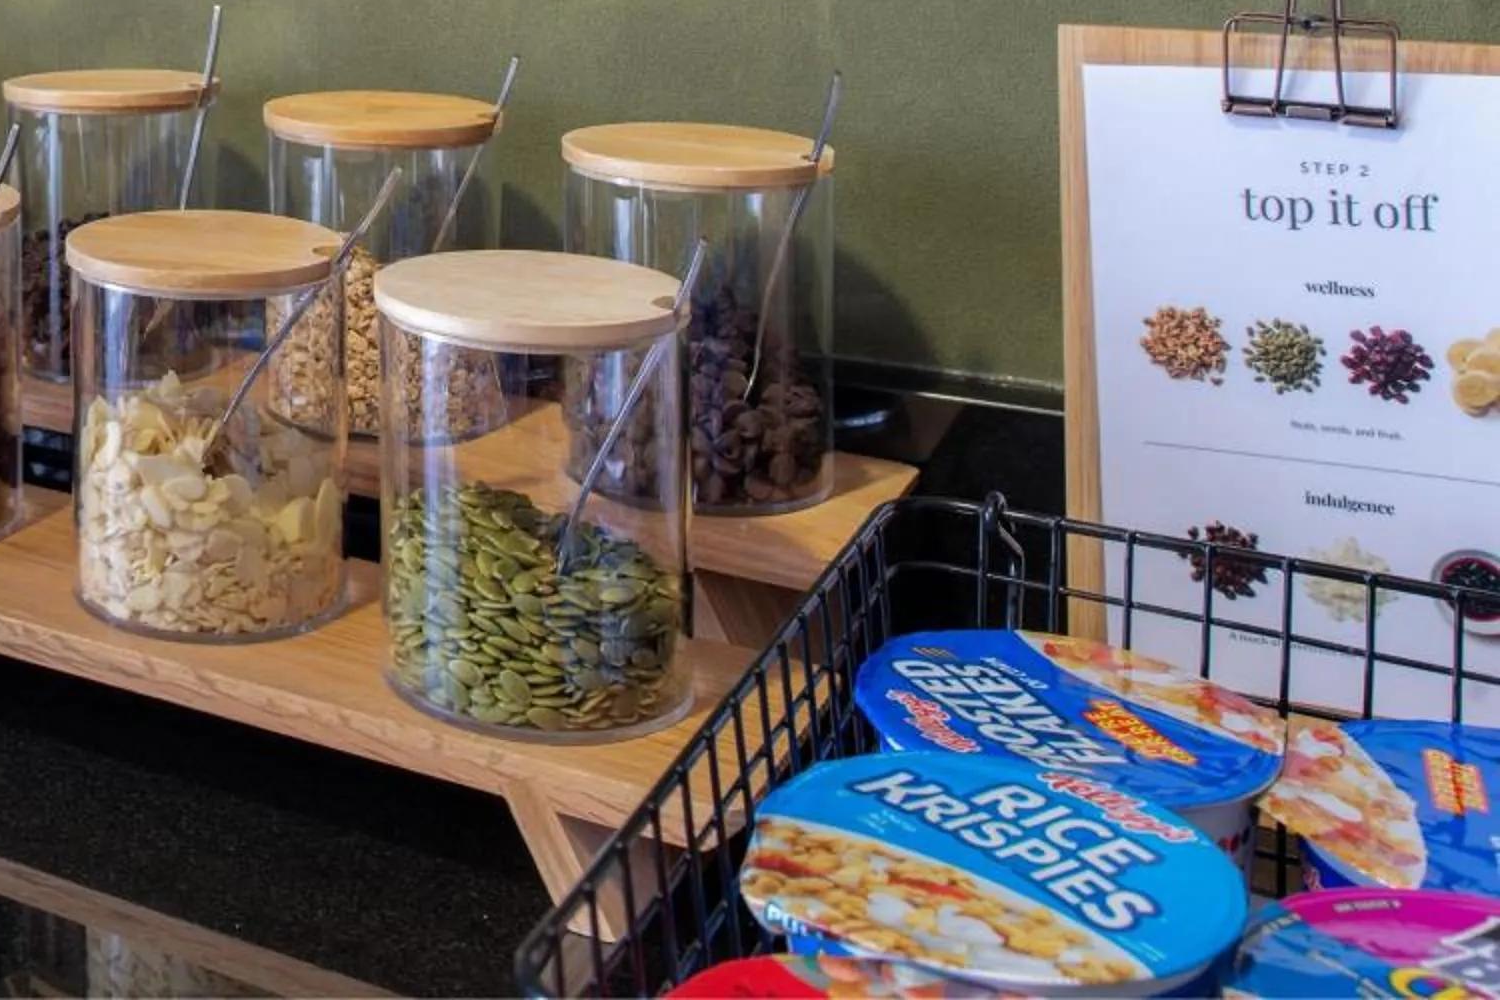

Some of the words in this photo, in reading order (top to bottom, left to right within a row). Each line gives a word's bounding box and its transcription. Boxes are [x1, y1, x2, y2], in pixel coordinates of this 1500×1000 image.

[1300, 161, 1350, 176] STEP
[1359, 164, 1371, 178] 2
[1241, 188, 1314, 231] top
[1328, 189, 1362, 227] it
[1373, 193, 1440, 232] off
[1305, 280, 1376, 298] wellness
[1304, 489, 1397, 516] indulgence
[892, 659, 1097, 774] FROSTED
[952, 660, 1127, 764] FLAKES
[970, 784, 1155, 876] RICE
[1036, 771, 1197, 842] Kellogg's
[854, 771, 1157, 930] KRISPIES
